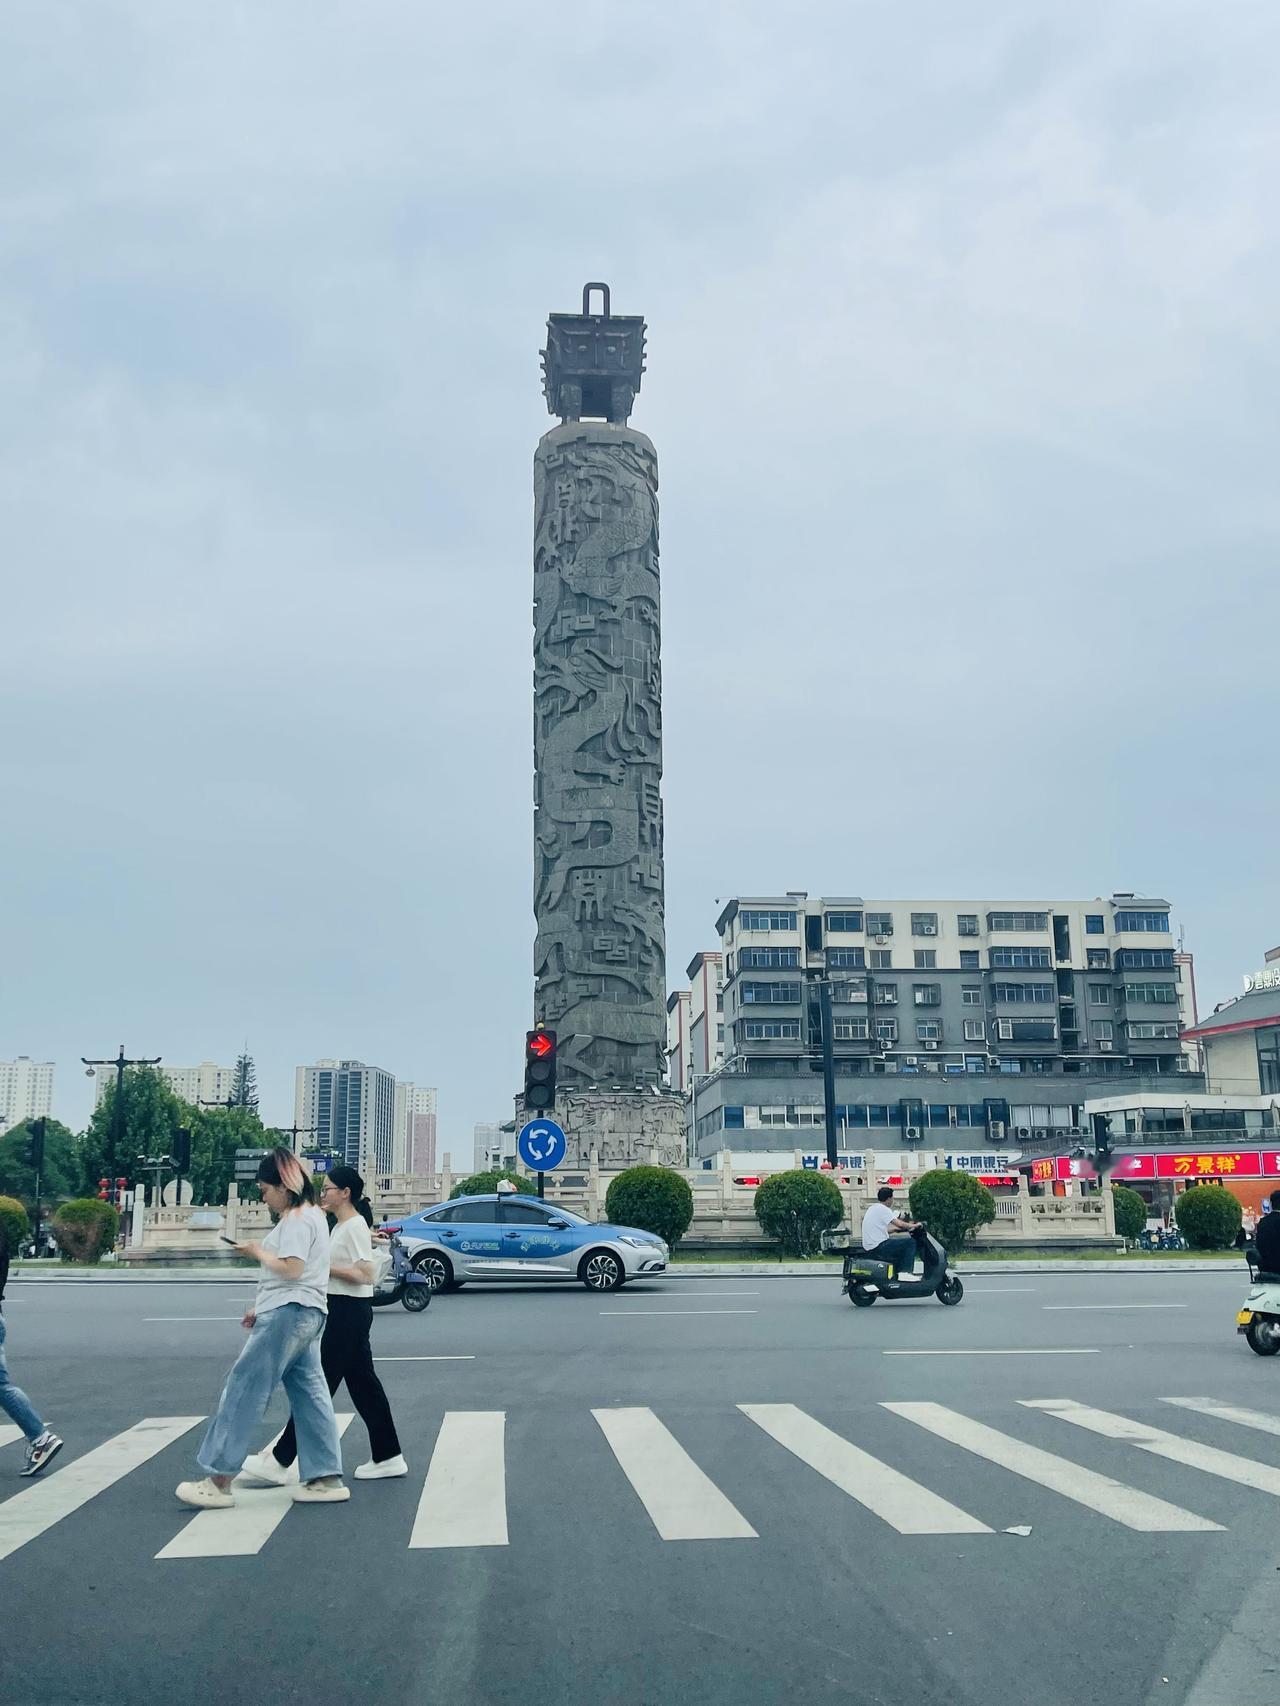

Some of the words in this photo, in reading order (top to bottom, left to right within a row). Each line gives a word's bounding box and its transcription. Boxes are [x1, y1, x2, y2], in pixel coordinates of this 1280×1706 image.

[956, 1155, 1008, 1168] 中原银行
[1174, 1155, 1236, 1174] 万景祥
